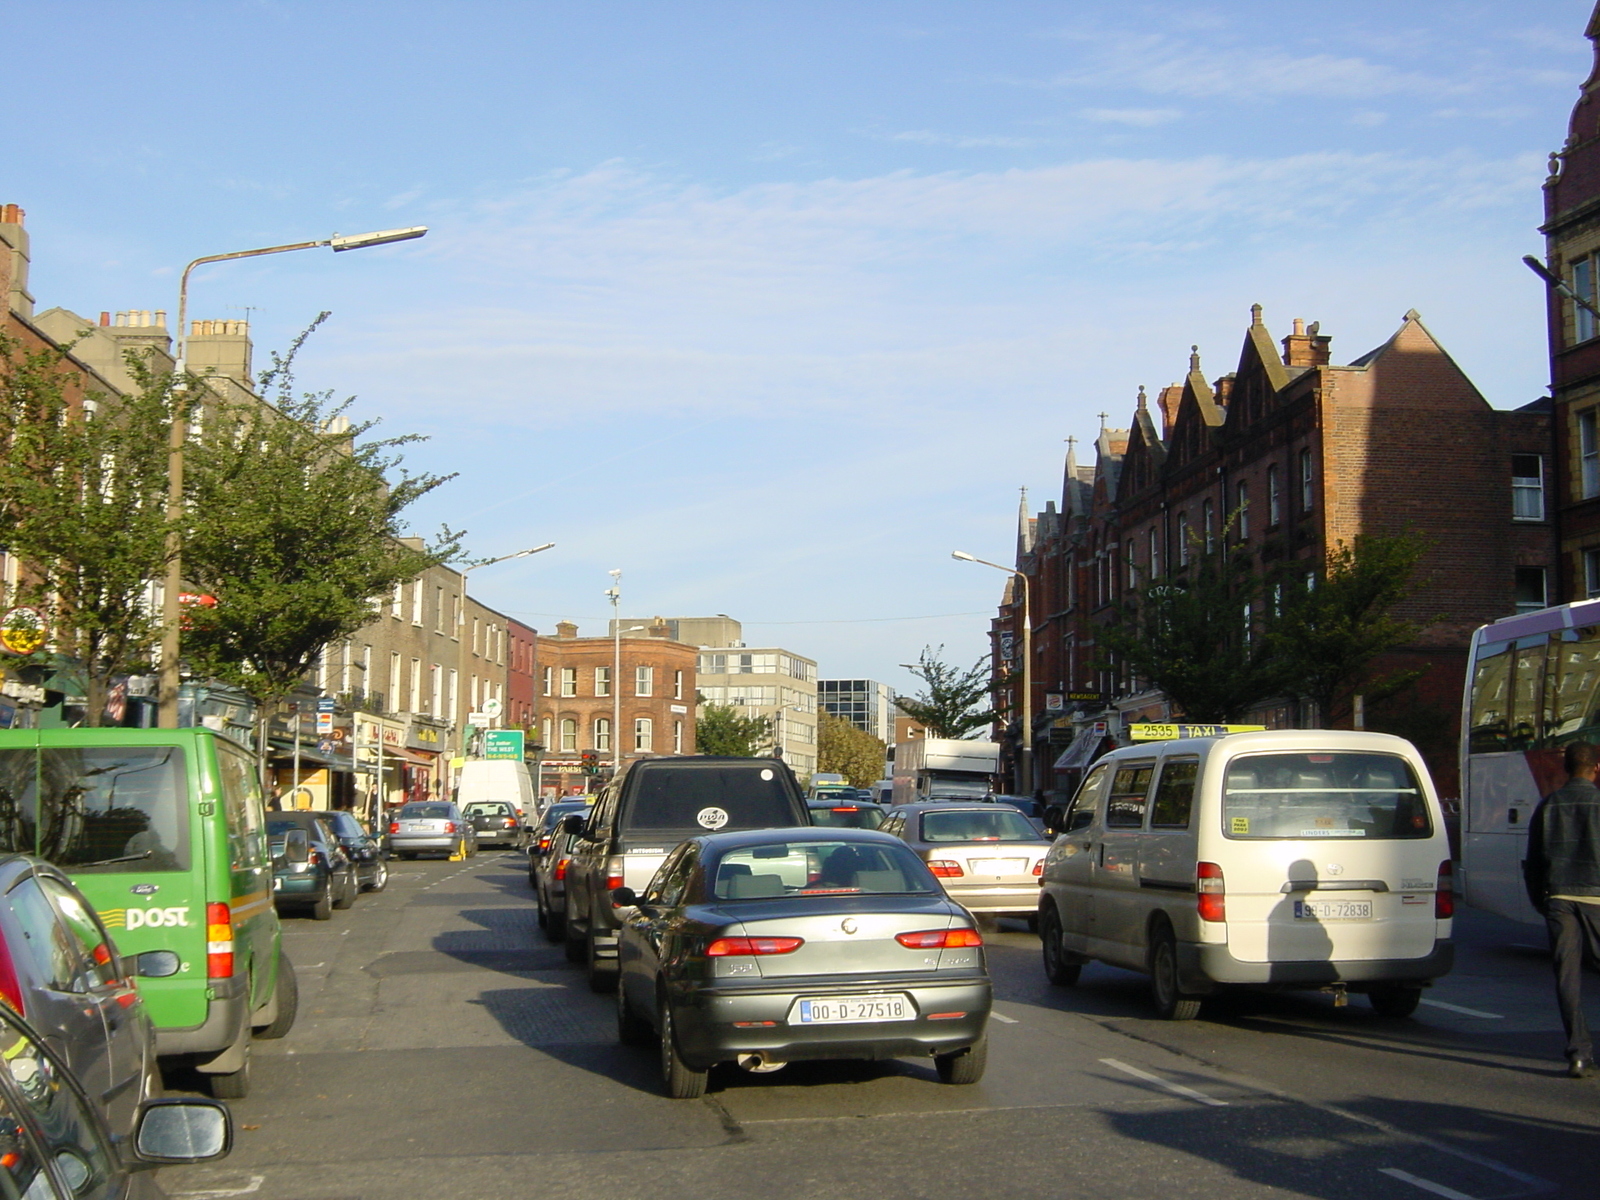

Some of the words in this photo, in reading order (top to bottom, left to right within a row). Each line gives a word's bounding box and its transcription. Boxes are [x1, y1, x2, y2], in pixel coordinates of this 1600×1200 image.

[1143, 725, 1173, 737] 2535
[1185, 726, 1215, 738] TAXI
[812, 1002, 902, 1020] 00-D-27518
